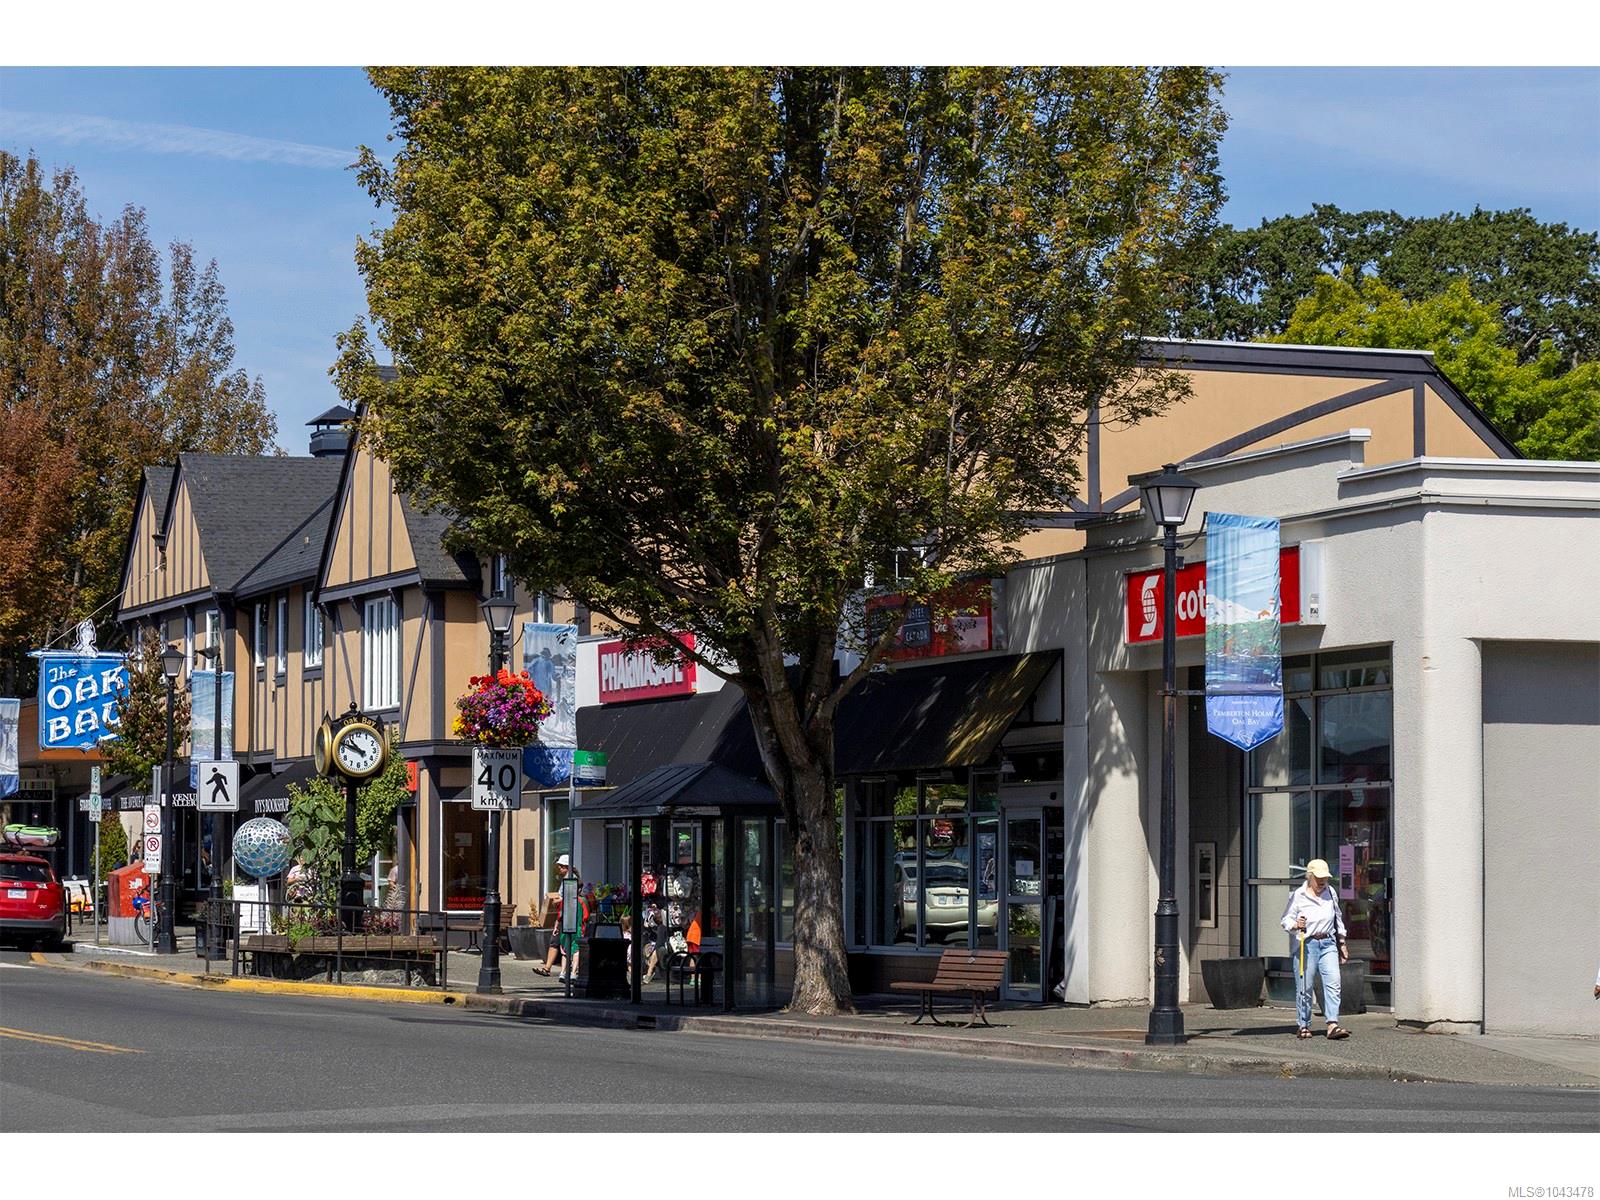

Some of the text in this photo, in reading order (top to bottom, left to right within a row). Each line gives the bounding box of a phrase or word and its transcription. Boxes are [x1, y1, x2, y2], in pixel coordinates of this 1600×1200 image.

[49, 666, 78, 682] The
[47, 665, 125, 710] OAK
[343, 716, 377, 728] Oak Bay
[477, 752, 518, 761] MAXIMUM
[477, 764, 517, 792] 40
[172, 793, 198, 801] VENU
[480, 795, 513, 807] km/h
